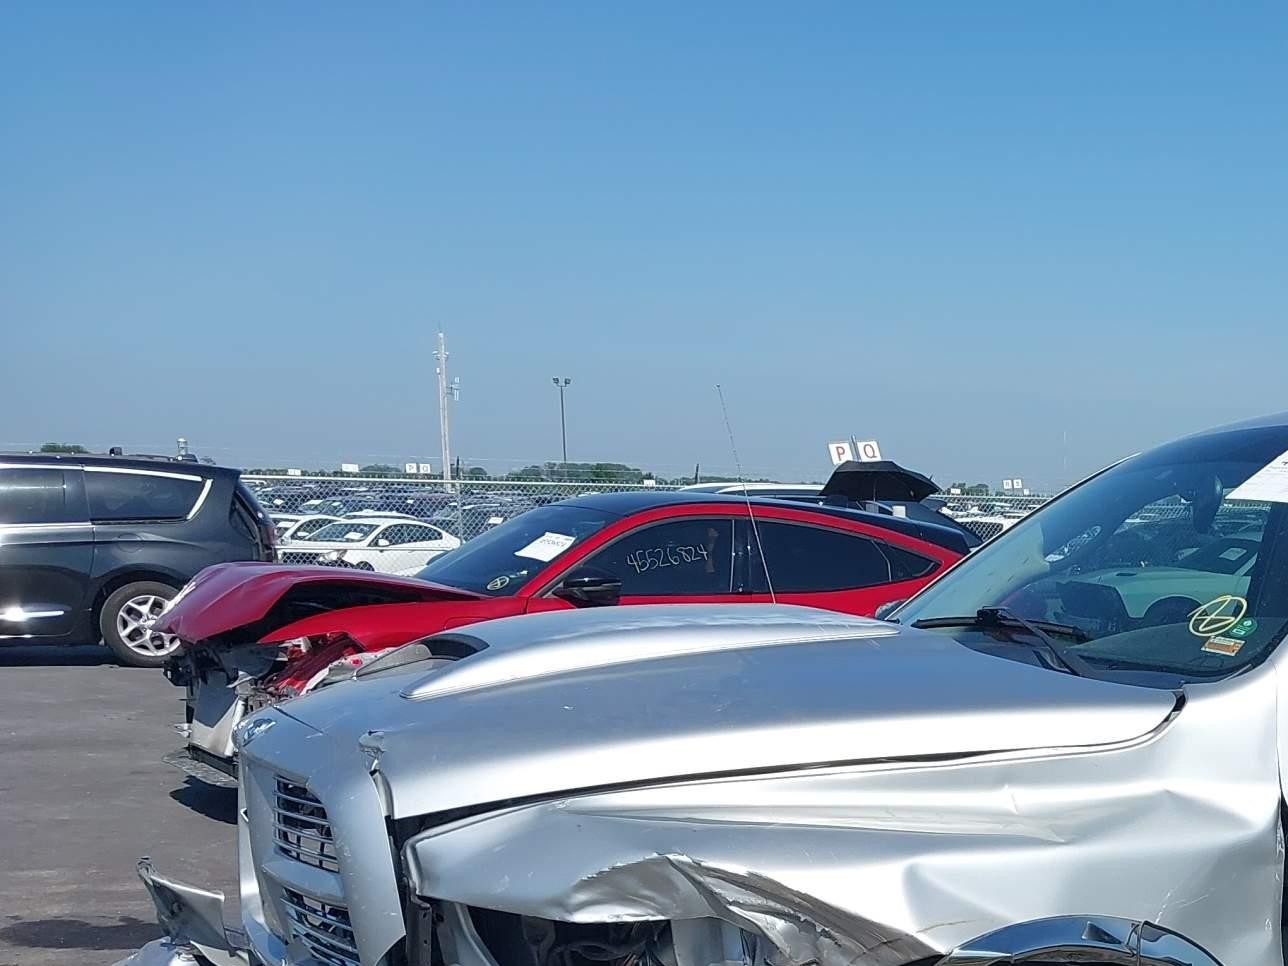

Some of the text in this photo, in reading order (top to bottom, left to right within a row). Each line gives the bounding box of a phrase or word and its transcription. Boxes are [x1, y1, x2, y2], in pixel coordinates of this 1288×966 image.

[836, 446, 846, 462] P
[863, 443, 877, 459] Q
[626, 543, 709, 574] 45526824
